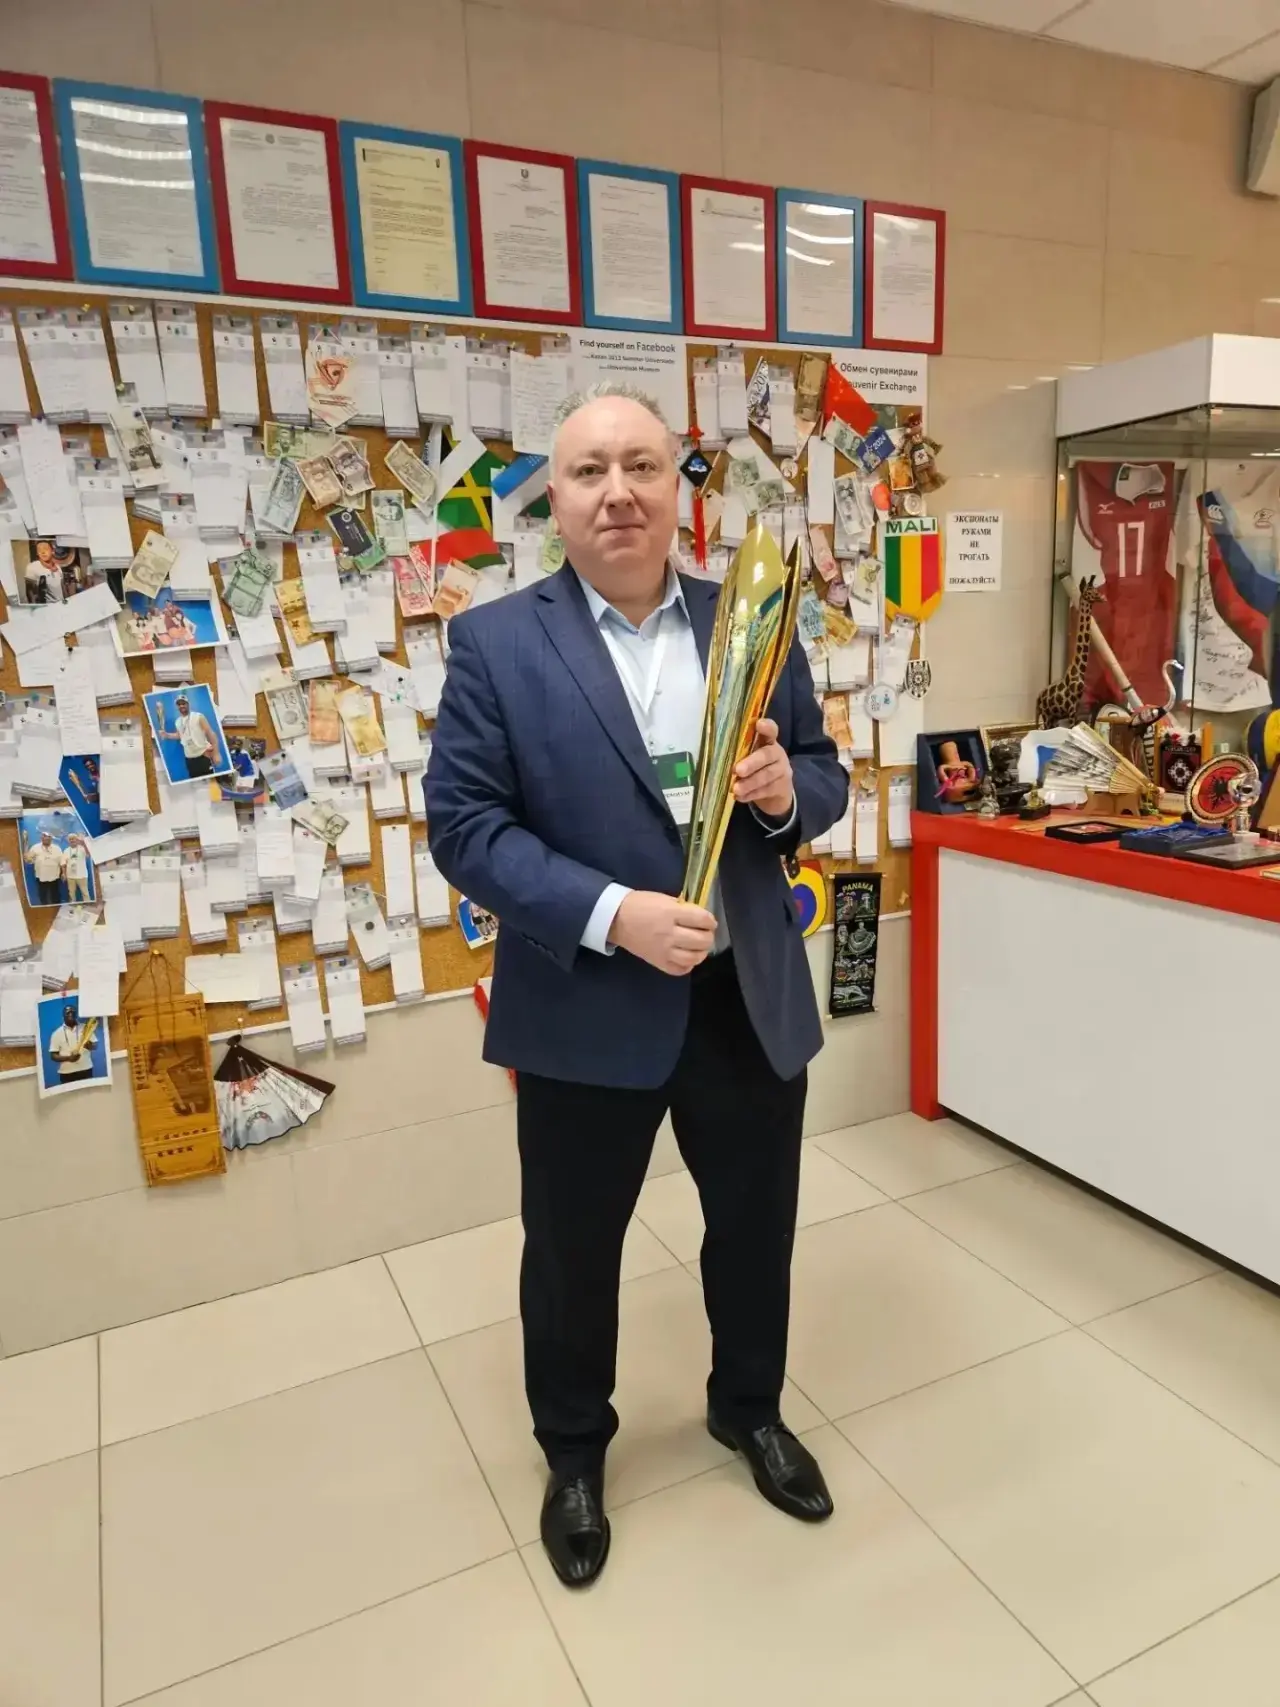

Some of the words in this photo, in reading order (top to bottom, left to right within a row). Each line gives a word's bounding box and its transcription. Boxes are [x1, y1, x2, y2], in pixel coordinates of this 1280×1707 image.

[580, 339, 595, 347] Find
[596, 341, 625, 350] yourself
[637, 342, 676, 353] Facebook
[840, 362, 868, 373] Обмен
[870, 365, 918, 378] сувенирами
[879, 381, 917, 393] Exchange
[954, 514, 999, 523] ЭКСПОНАТЫ
[886, 518, 936, 534] MALI
[961, 528, 992, 536] РУКАМИ
[1118, 522, 1145, 578] 17
[958, 553, 990, 561] ТРОГАТЬ
[949, 576, 996, 584] ПОЖАЛУЙСТА
[842, 882, 874, 893] PANAMA
